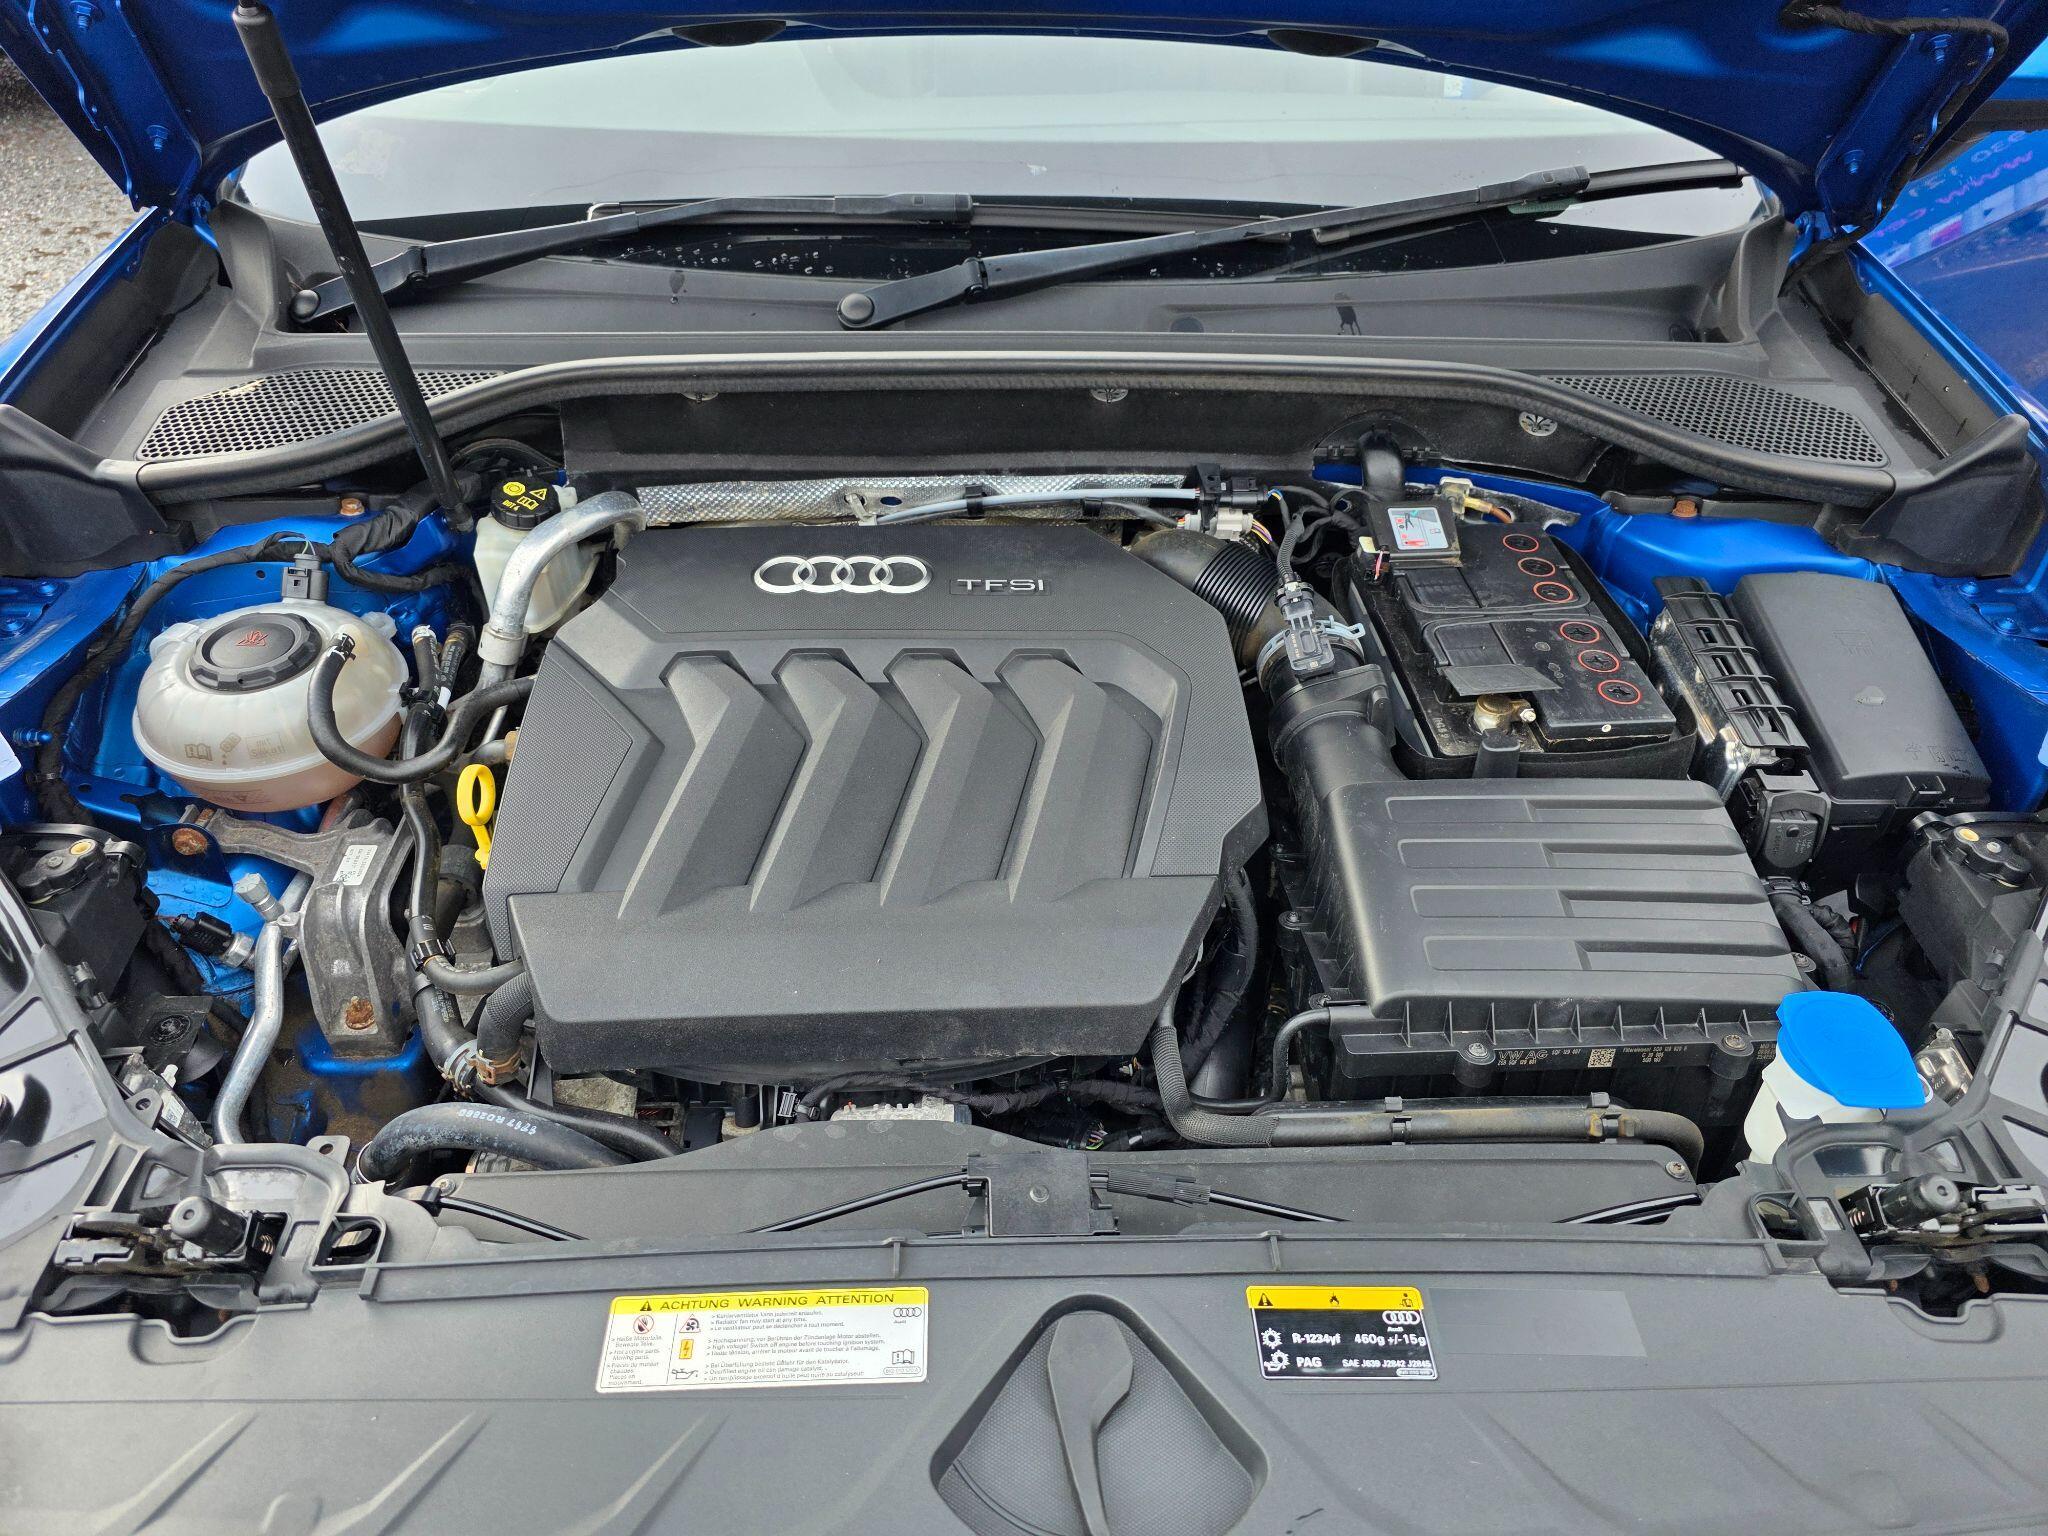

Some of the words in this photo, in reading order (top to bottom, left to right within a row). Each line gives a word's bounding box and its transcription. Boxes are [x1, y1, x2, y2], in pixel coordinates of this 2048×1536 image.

[956, 578, 1044, 591] TFSI
[1498, 1050, 1524, 1060] VW
[1525, 1050, 1549, 1060] AG
[660, 1299, 730, 1310] ACHTUNG
[738, 1296, 808, 1308] WARNING
[816, 1294, 894, 1304] ATTENTION
[1292, 1333, 1341, 1346] R-1234yf
[1354, 1334, 1386, 1346] 460g
[1388, 1334, 1427, 1346] +/-15g
[1296, 1356, 1322, 1368] PAG
[1342, 1360, 1360, 1368] SAE
[1362, 1360, 1380, 1368] J639
[1382, 1360, 1406, 1368] J2842
